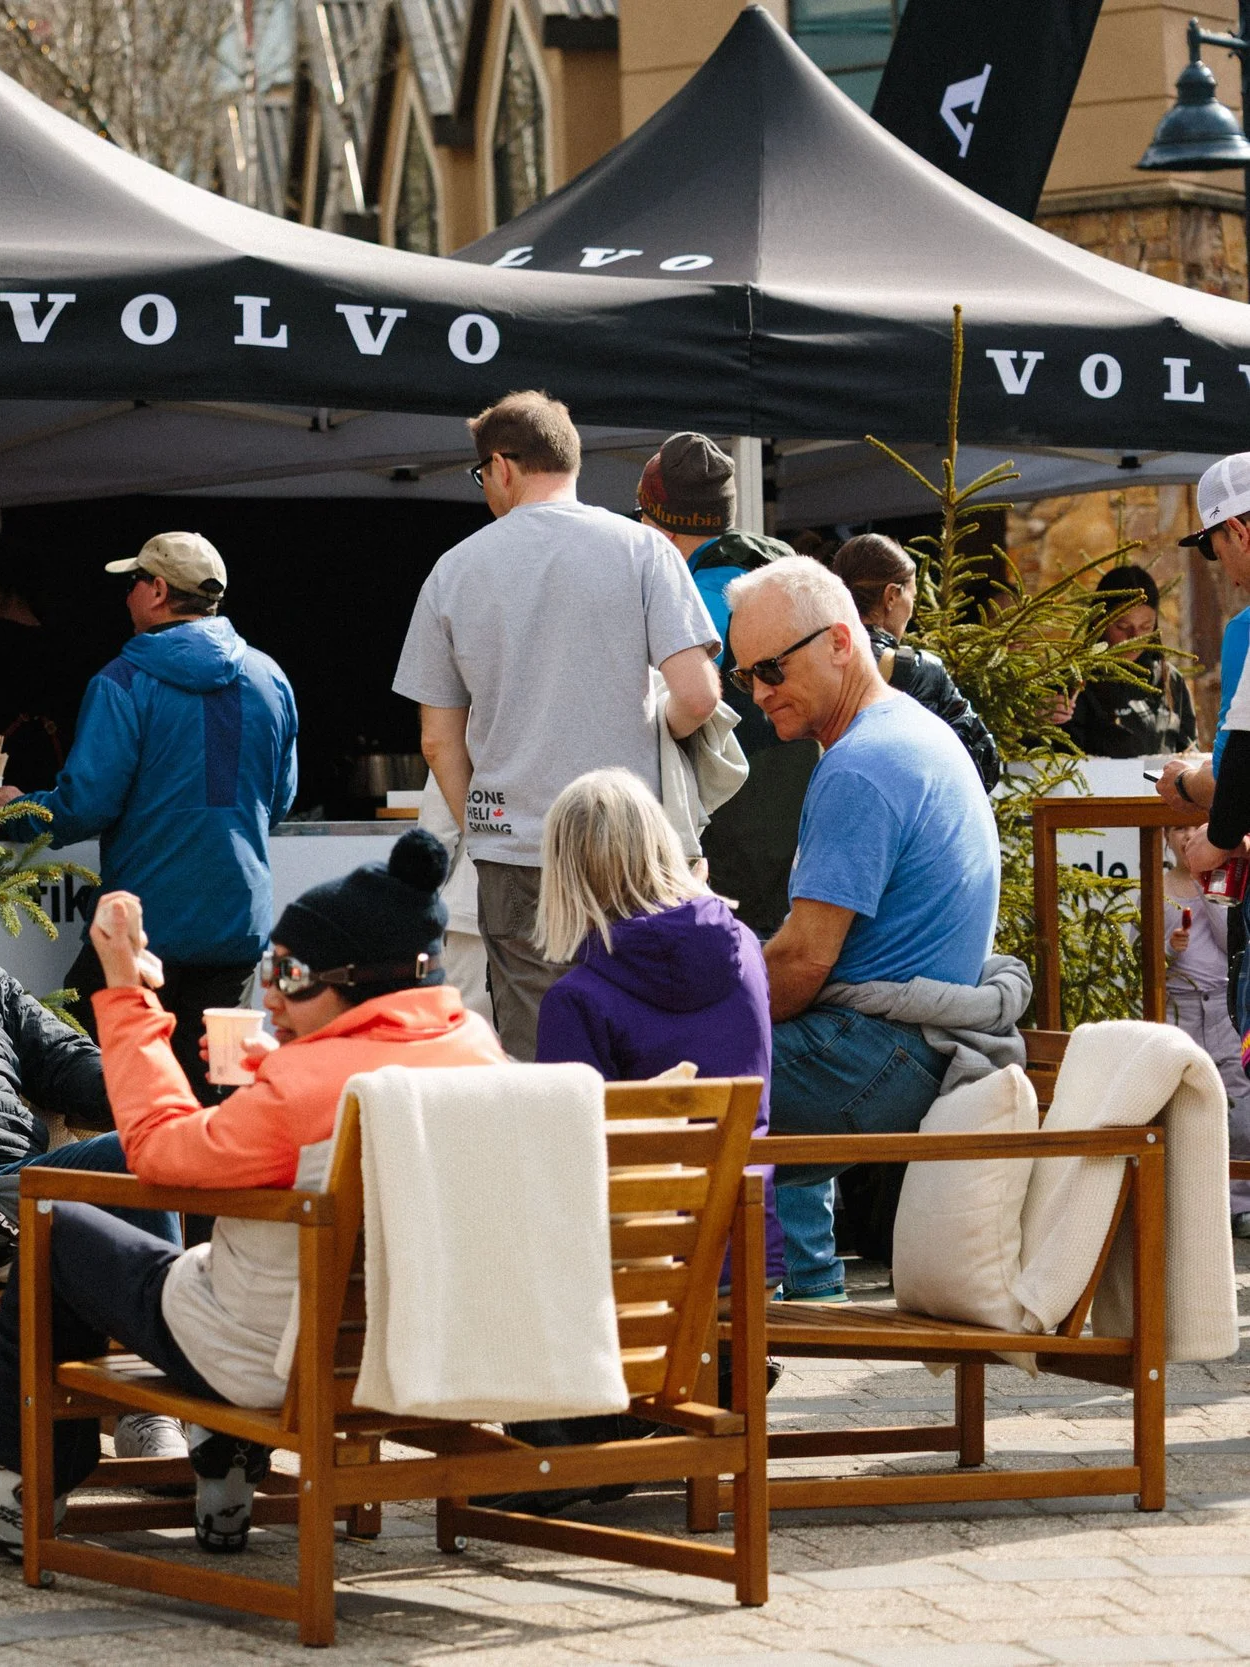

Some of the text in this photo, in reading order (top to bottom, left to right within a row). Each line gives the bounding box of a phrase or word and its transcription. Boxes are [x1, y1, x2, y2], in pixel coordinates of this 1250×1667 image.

[0, 291, 501, 364] VOLVO
[985, 349, 1250, 403] VOL
[467, 806, 490, 821] HELI
[469, 821, 512, 835] SKIING
